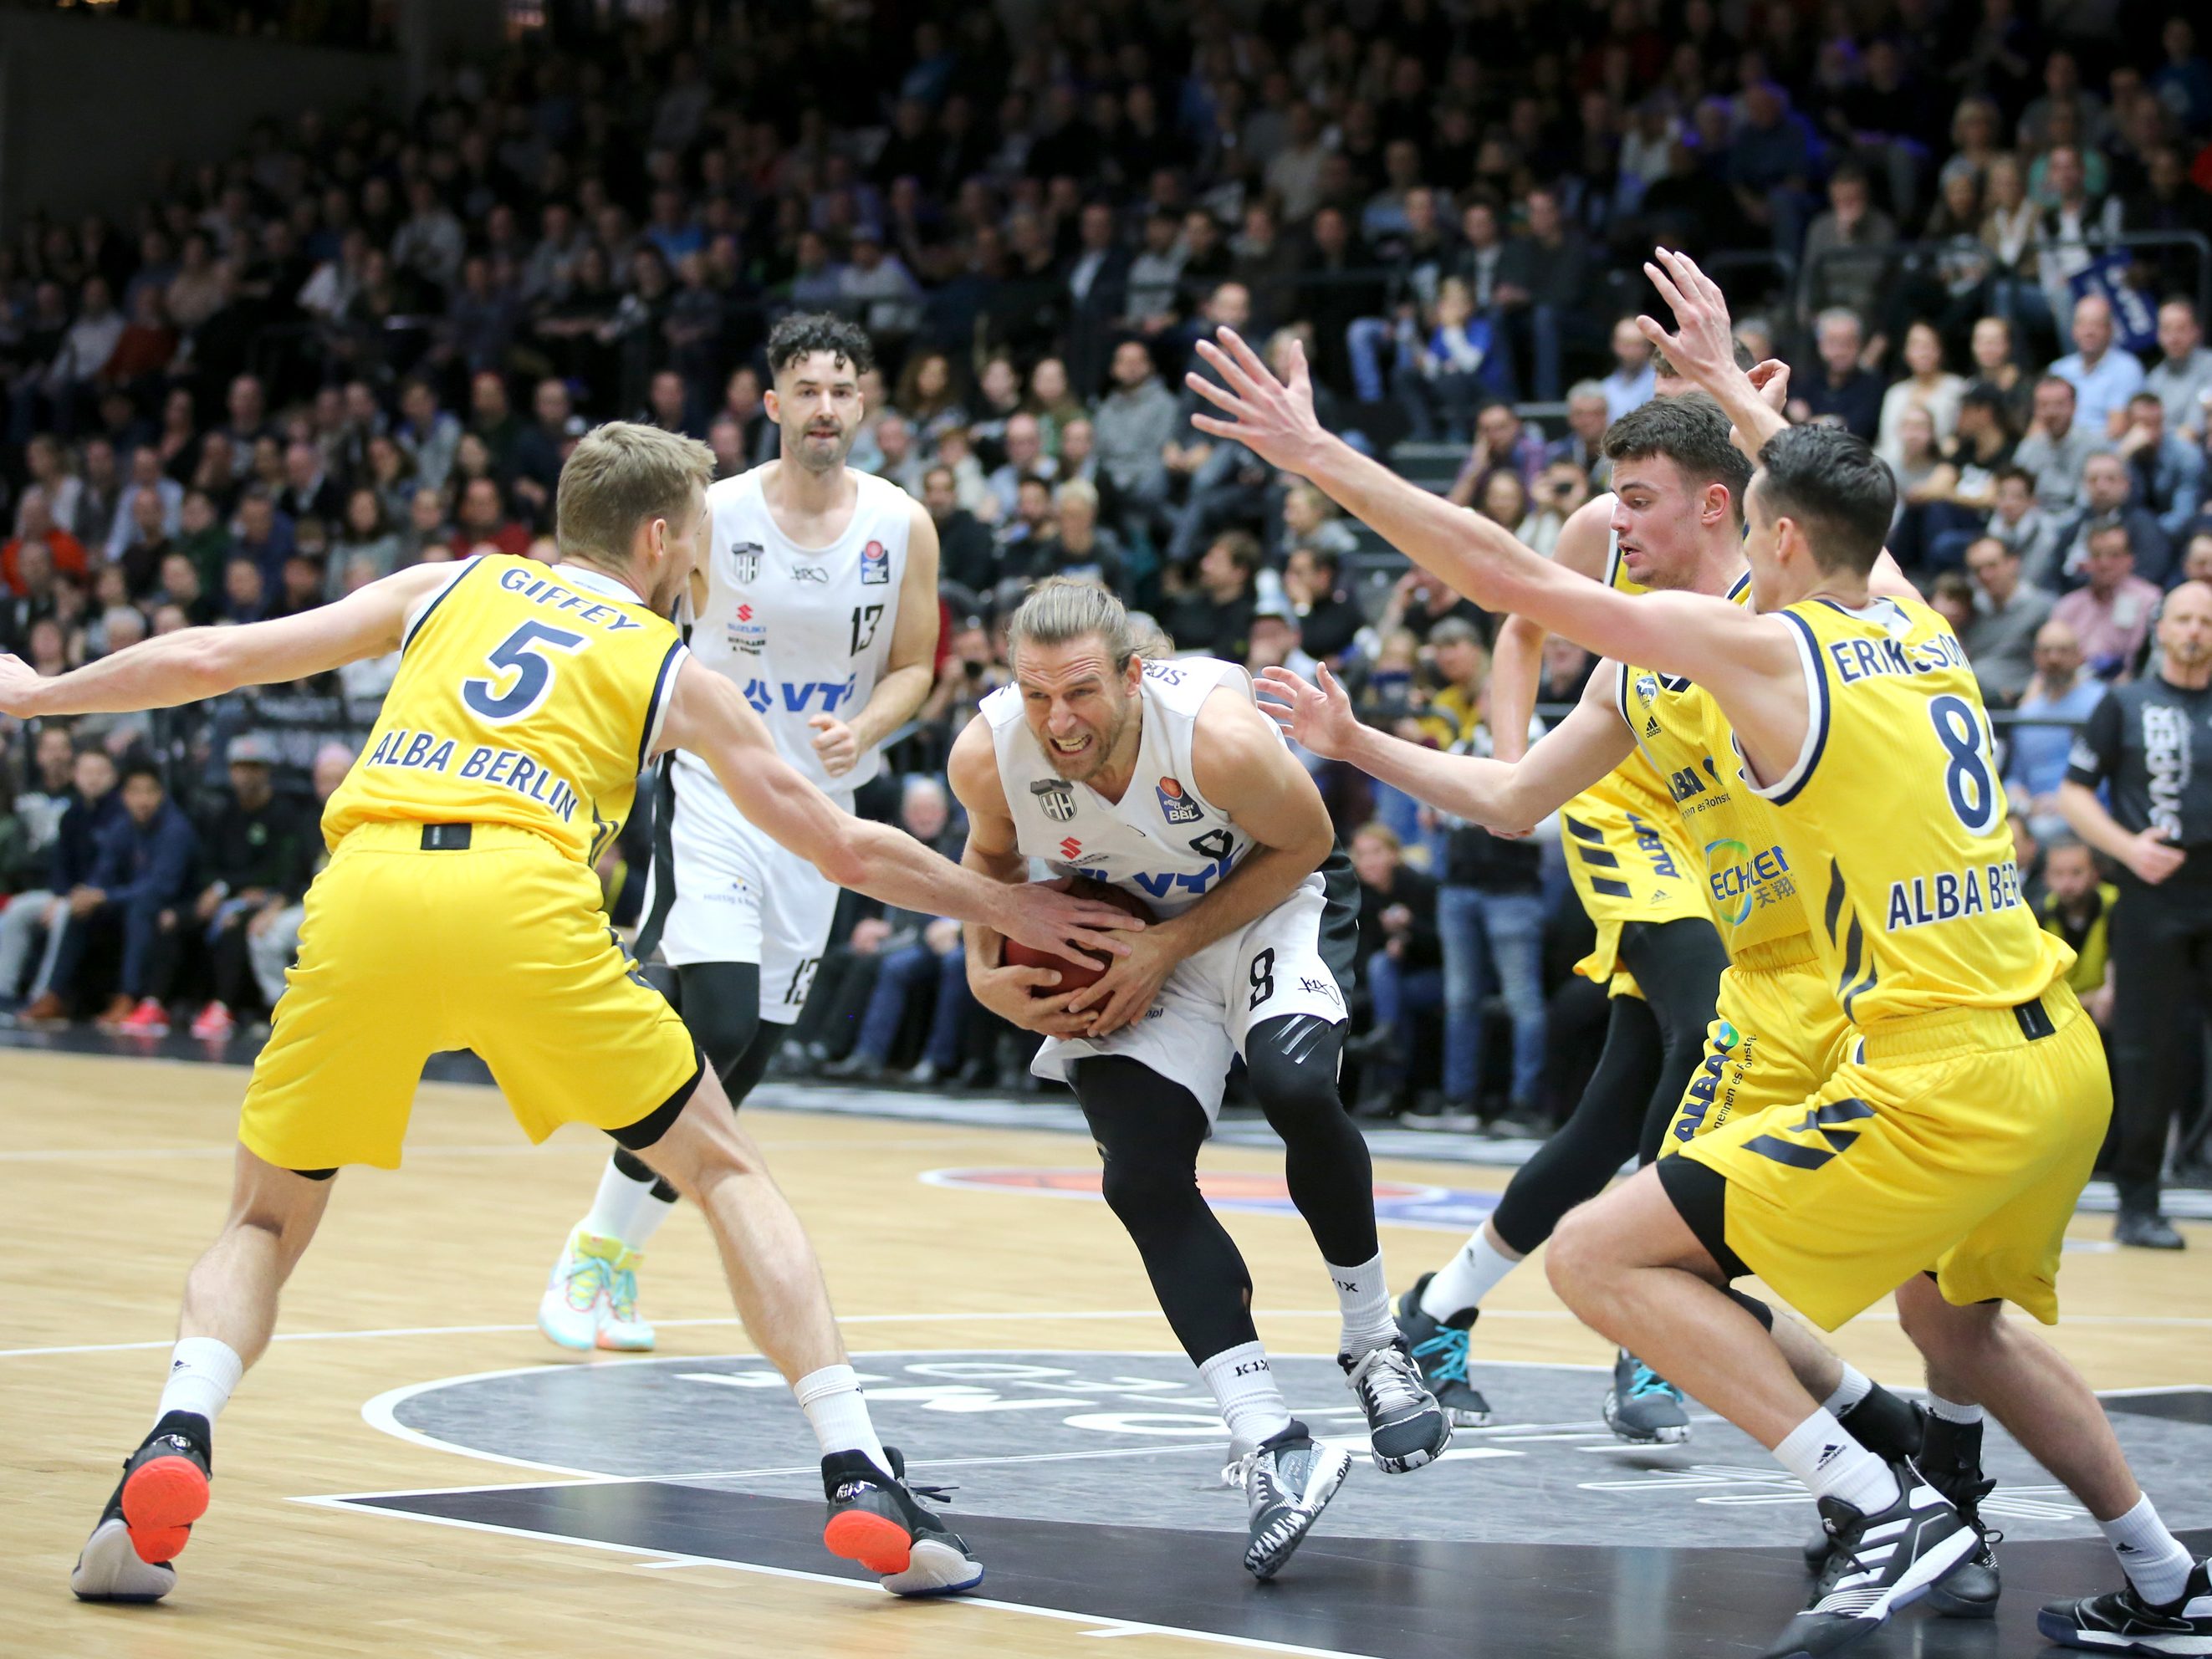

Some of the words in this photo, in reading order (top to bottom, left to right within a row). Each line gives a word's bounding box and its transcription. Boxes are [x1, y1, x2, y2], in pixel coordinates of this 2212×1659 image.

[499, 567, 644, 632] GIFFEY
[851, 604, 884, 656] 13
[462, 620, 585, 719] 5
[366, 730, 455, 771] ALBA
[460, 747, 578, 824] BERLIN
[1931, 696, 1991, 829] 8
[1169, 809, 1198, 820] BBL
[1888, 870, 1982, 929] ALBA
[1249, 947, 1275, 1012] 8
[1673, 1054, 1732, 1143] ALBA
[1732, 1069, 1744, 1085] es
